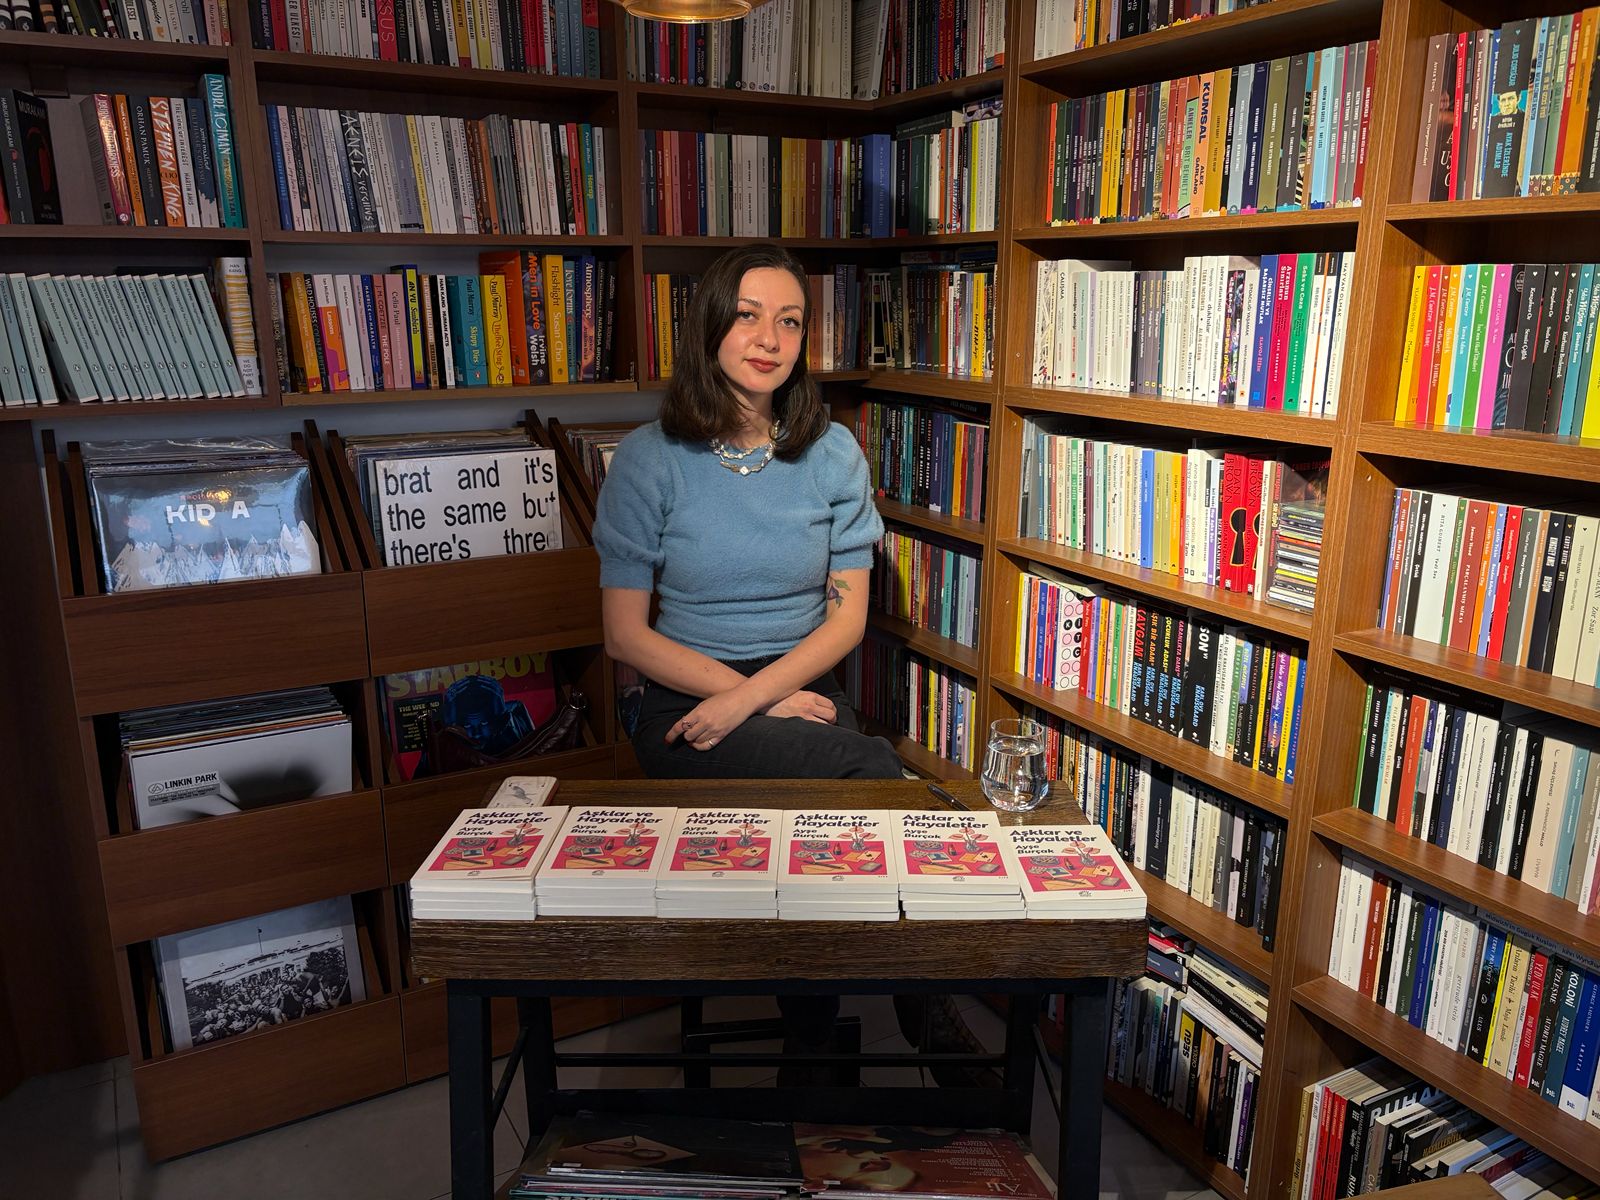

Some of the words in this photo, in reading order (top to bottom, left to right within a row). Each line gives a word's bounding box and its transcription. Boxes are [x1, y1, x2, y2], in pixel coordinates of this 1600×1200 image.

[1511, 44, 1520, 59] JULIO
[1, 97, 10, 117] HARUKI
[136, 106, 146, 135] ORHAN
[1199, 82, 1211, 143] KUMSAL
[4, 118, 13, 147] MURAKAMI
[214, 111, 231, 155] ACIMAN
[1186, 107, 1194, 139] ANNELER
[140, 138, 150, 164] PAMUK
[340, 114, 368, 177] AENEIS
[1505, 132, 1513, 147] AYAK
[150, 100, 175, 171] STEPHEN
[166, 181, 183, 221] KING
[1494, 142, 1503, 169] ADIMLAR
[1501, 147, 1511, 177] İZLERİNDE
[528, 256, 538, 282] Men
[409, 281, 415, 291] AN
[530, 286, 539, 297] in
[550, 265, 560, 306] Flashlight
[582, 263, 593, 319] Atmosphere
[1278, 266, 1286, 300] Sınırları
[1284, 266, 1292, 300] Arzunun
[309, 297, 317, 323] HOUSES
[410, 293, 416, 302] YU
[327, 311, 335, 335] Lessons
[378, 300, 386, 329] COETZEE
[411, 307, 419, 334] Sunbirth
[531, 301, 541, 330] Love
[553, 312, 562, 337] Susan
[470, 326, 478, 346] Skippy
[538, 335, 546, 364] Irvine
[530, 335, 539, 365] Welsh
[555, 341, 563, 361] Choi
[383, 466, 432, 496] brat
[457, 460, 500, 489] and
[524, 457, 553, 485] it's
[1225, 458, 1234, 504] BROWN
[166, 503, 216, 523] KID
[232, 501, 251, 519] A
[387, 503, 426, 531] the
[443, 500, 506, 527] same
[391, 533, 471, 566] there's
[503, 528, 551, 555] thre
[1199, 626, 1209, 653] SON
[165, 778, 192, 789] LINKIN
[195, 773, 217, 783] PARK
[465, 817, 551, 825] Hayaletler
[795, 820, 879, 828] Hayaletler
[1508, 975, 1518, 993] Tarihi
[1533, 963, 1544, 982] YEDİ
[1548, 965, 1563, 1004] YÜZLEŞME
[1455, 975, 1463, 1003] gertrude
[1529, 983, 1539, 1000] ULAK
[1565, 972, 1579, 1008] KOLONİ
[1451, 1005, 1460, 1022] stein
[1560, 1016, 1569, 1036] AUDREY
[1542, 1016, 1552, 1042] AUDREY
[1535, 1044, 1547, 1069] MAGEE
[1556, 1037, 1564, 1054] MAGEE
